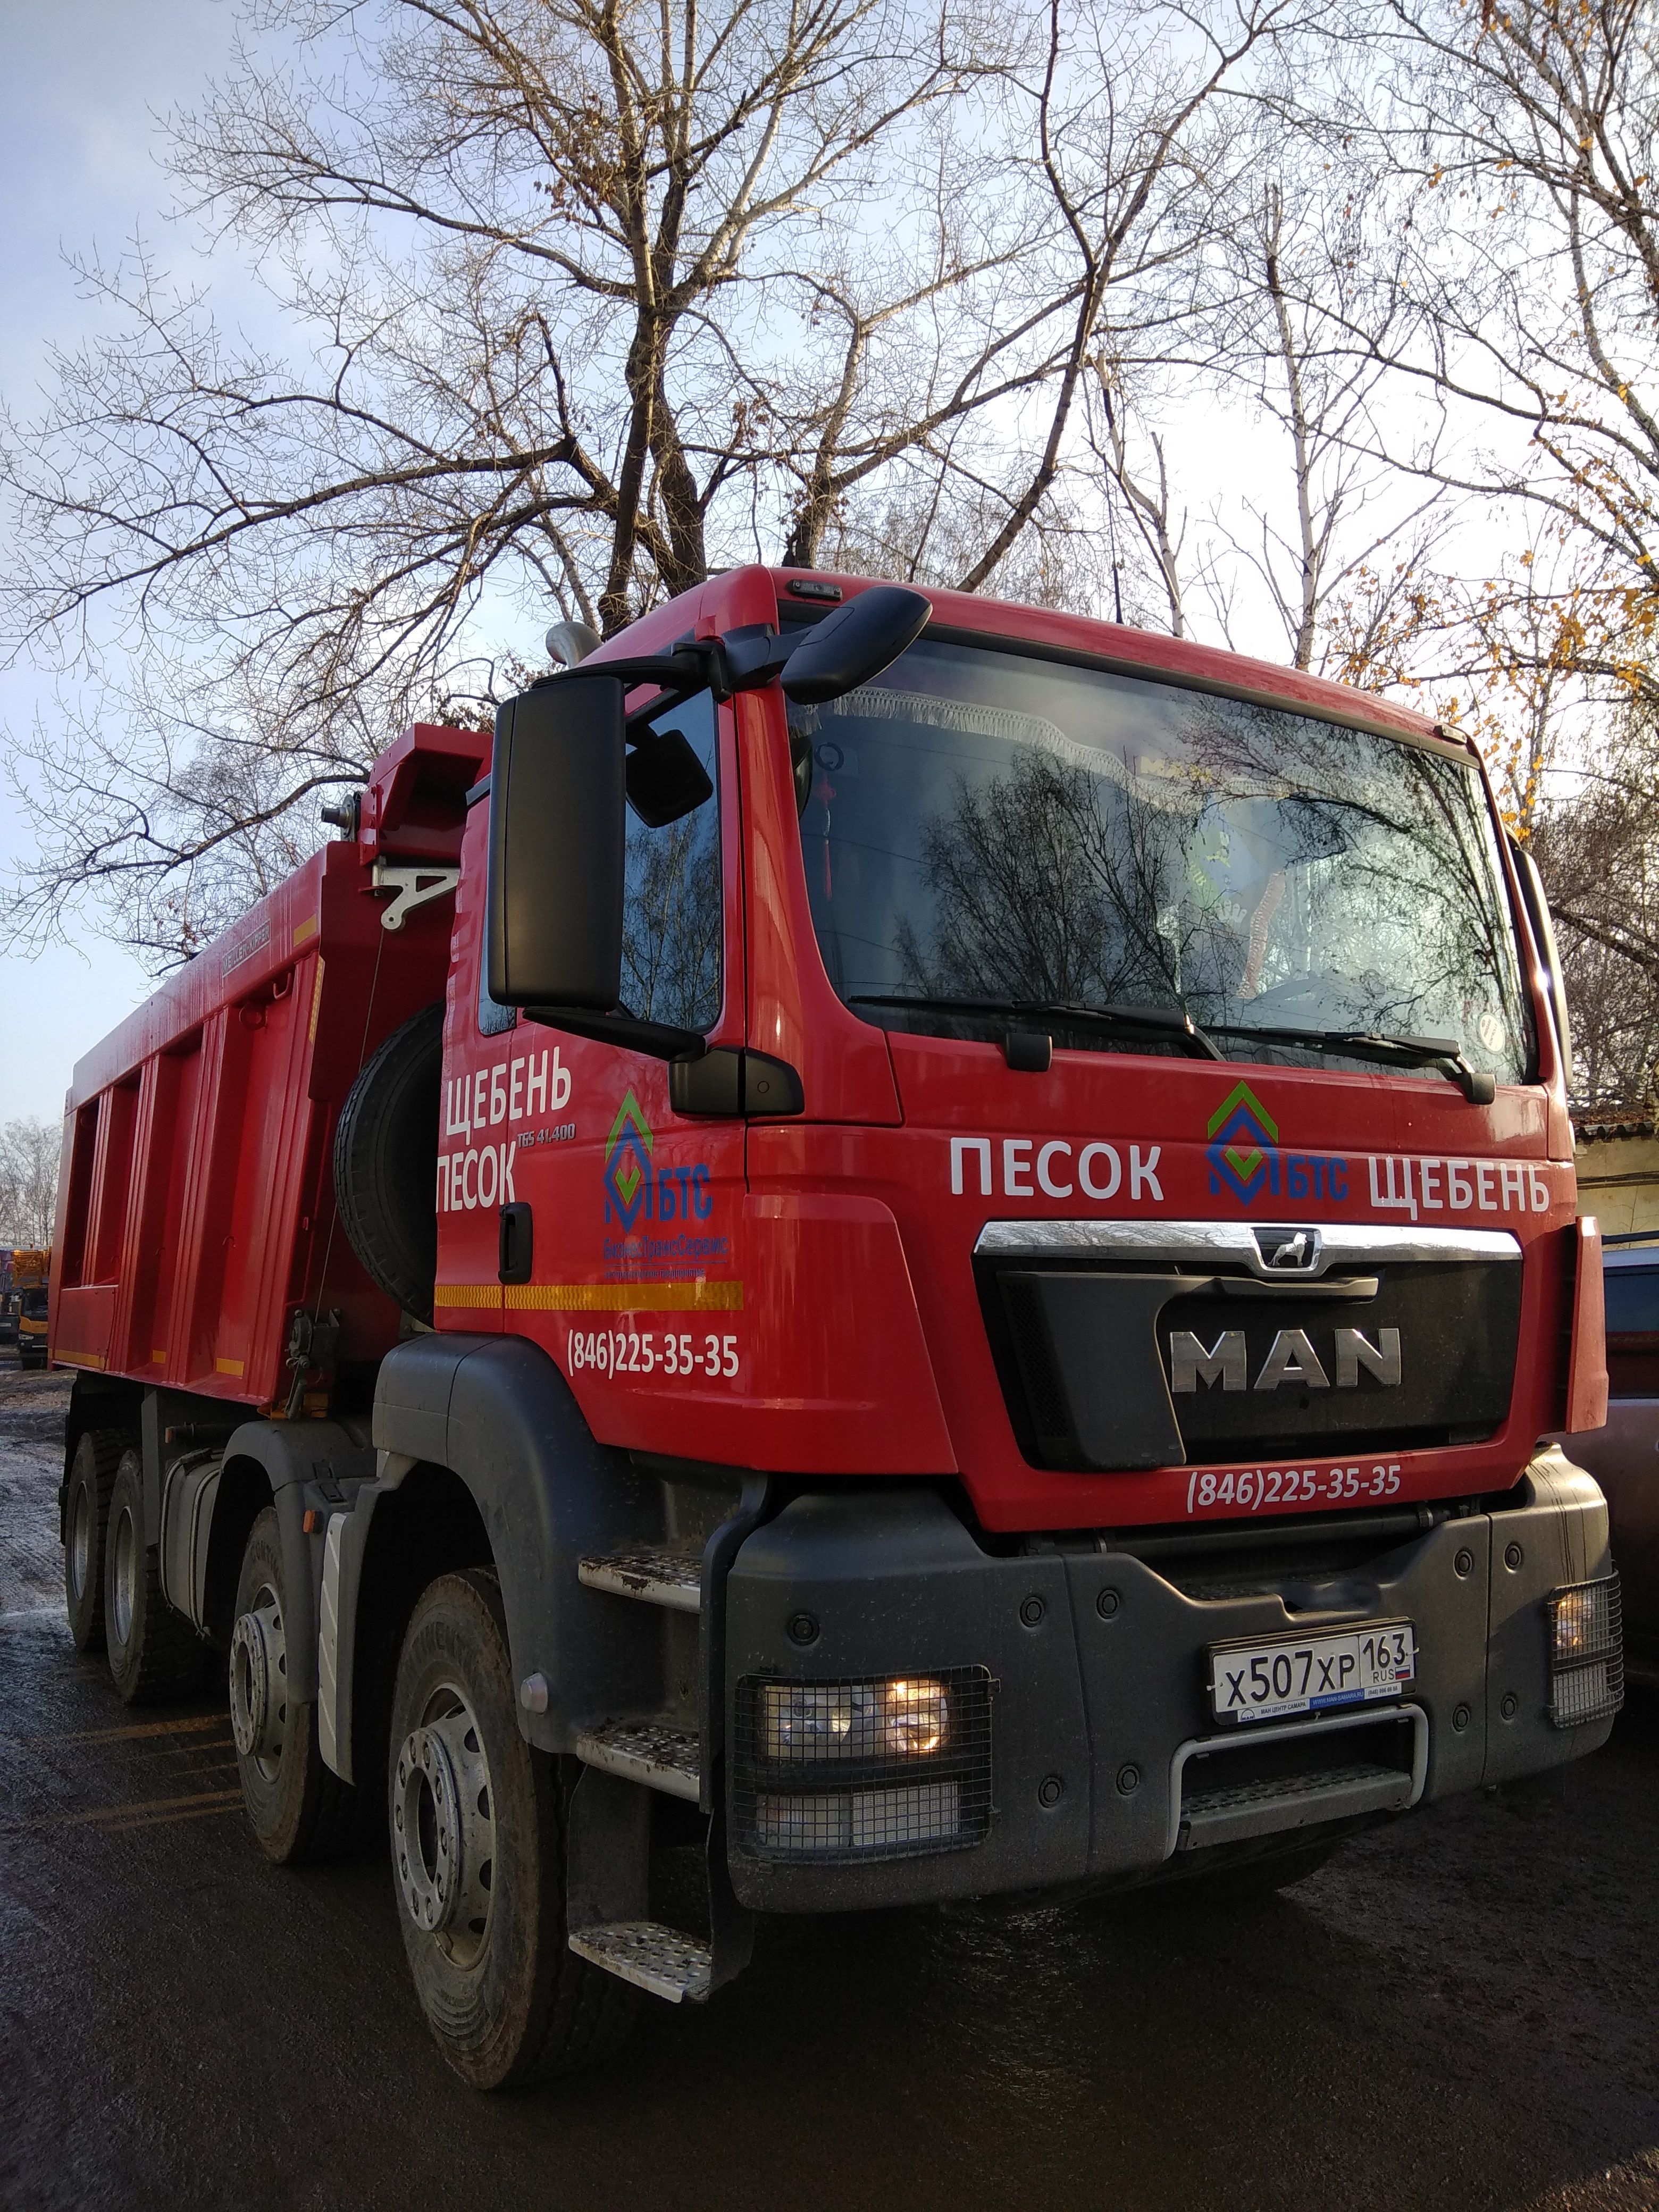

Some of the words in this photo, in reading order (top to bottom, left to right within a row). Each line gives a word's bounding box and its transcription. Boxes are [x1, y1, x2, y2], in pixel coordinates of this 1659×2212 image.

[446, 1046, 572, 1145] ЩЕБЕНЬ
[537, 1123, 575, 1144] 41.400
[435, 1141, 516, 1213] ПЕСОК
[658, 1163, 713, 1221] БТС
[950, 1137, 1164, 1201] ПЕСОК
[1287, 1155, 1348, 1202] БТС
[1368, 1155, 1550, 1221] ЩЕБЕНЬ
[568, 1329, 739, 1380] (846)225-35-35
[1170, 1328, 1402, 1393] MAN
[1187, 1465, 1401, 1514] (846)225-35-35
[1362, 1632, 1406, 1671] 163
[1372, 1669, 1395, 1683] RUS
[1287, 1701, 1306, 1710] САМАРА
